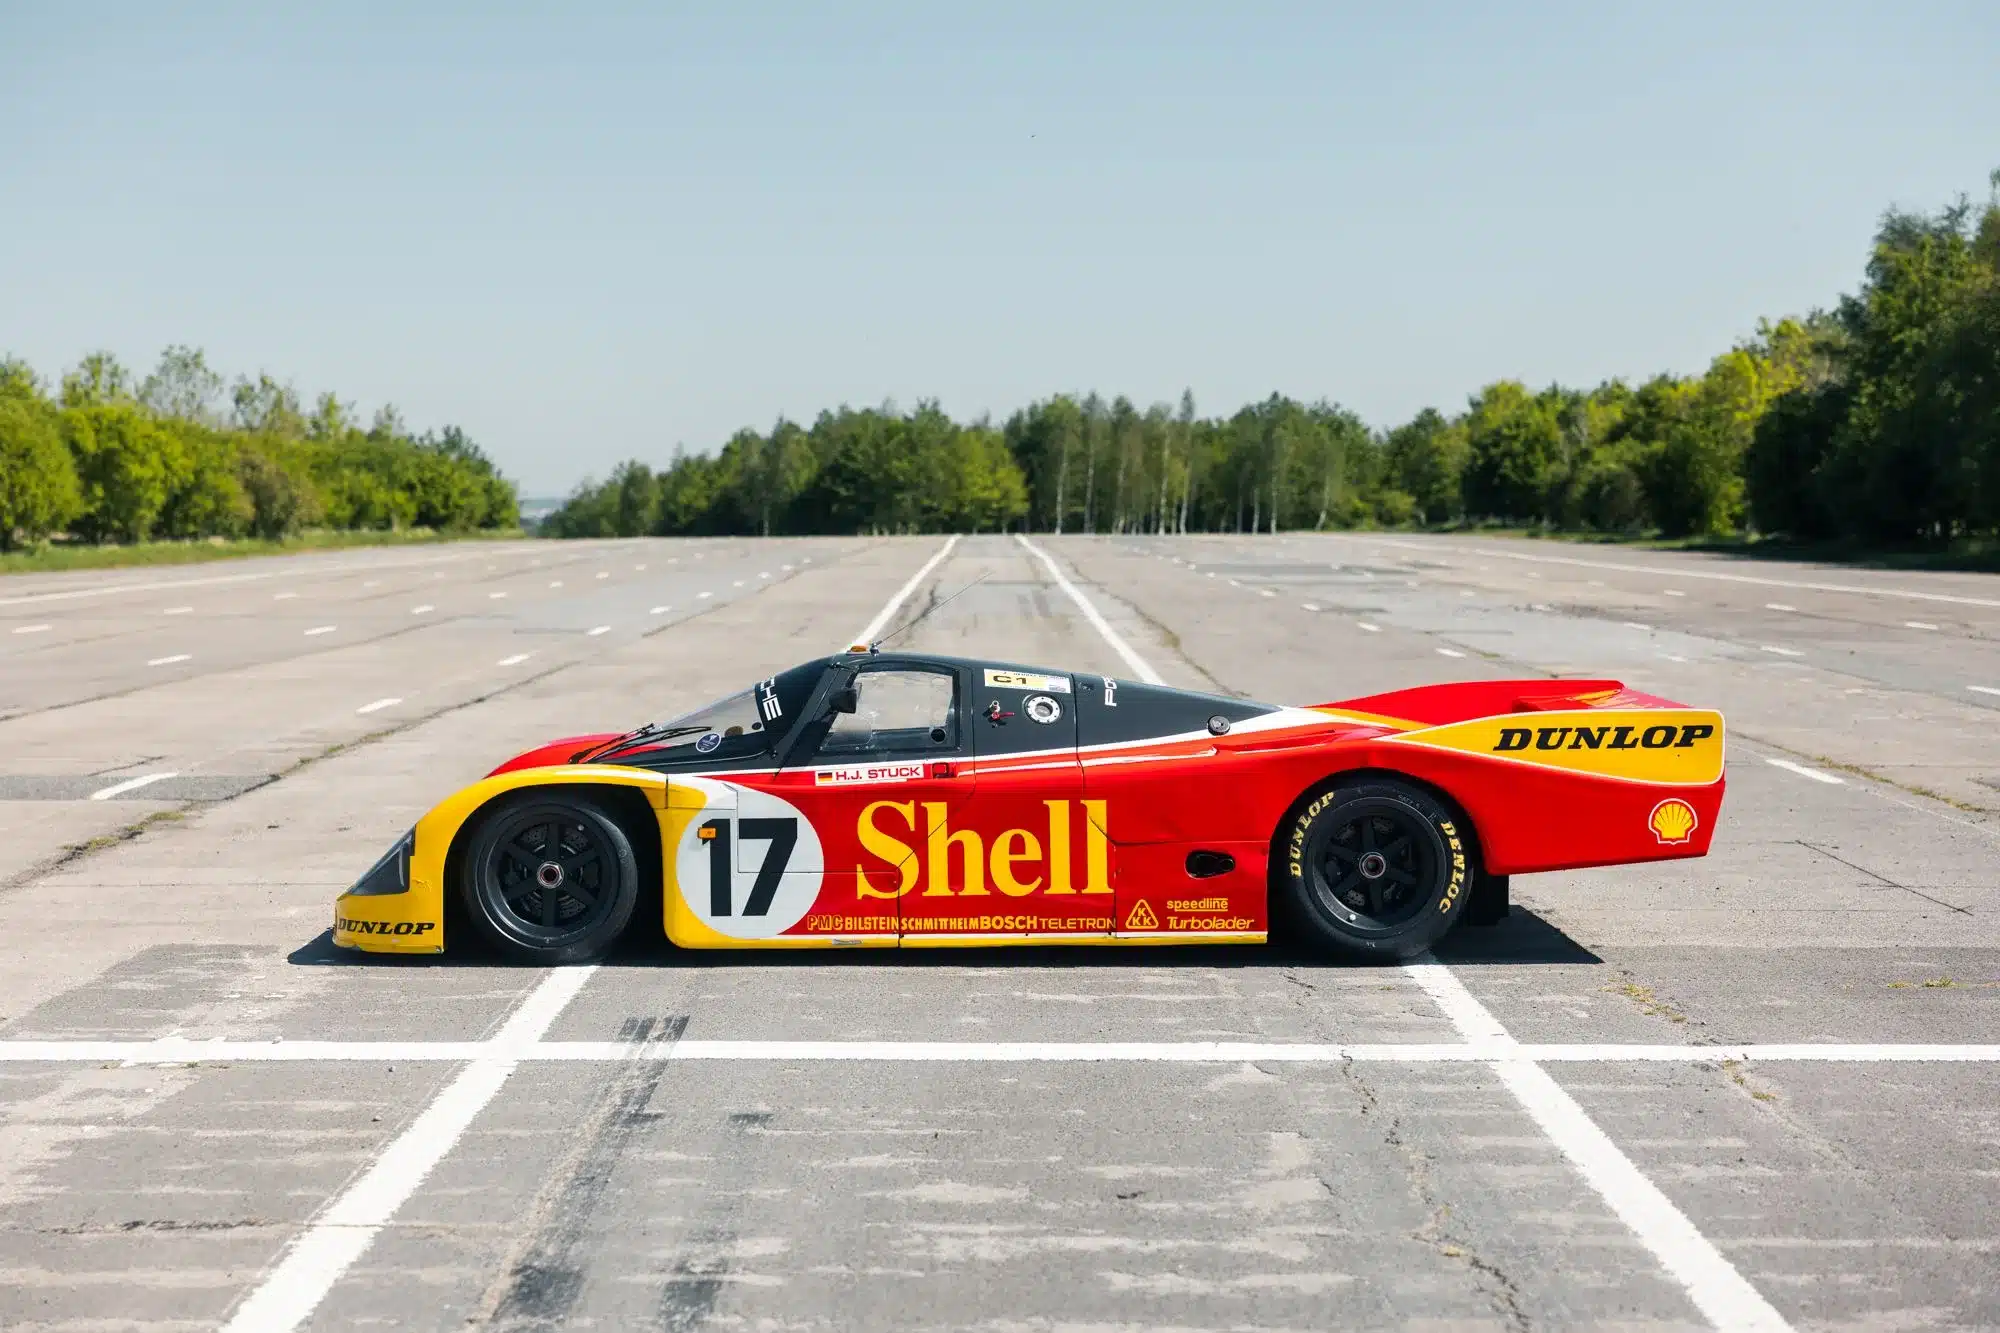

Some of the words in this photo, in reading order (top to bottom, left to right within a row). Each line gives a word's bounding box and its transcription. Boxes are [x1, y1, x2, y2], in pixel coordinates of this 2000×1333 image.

[993, 674, 1027, 685] C1
[1493, 724, 1713, 751] DUNLOP
[835, 770, 862, 781] H.J.
[868, 766, 921, 779] STUCK
[1289, 791, 1335, 878] DUNLOP
[856, 799, 1115, 900] Shell
[701, 817, 798, 917] 17
[1439, 820, 1466, 914] DENLOC
[1166, 898, 1229, 912] speedline
[338, 918, 435, 936] DUNLOP
[845, 917, 899, 931] BILSTEIN
[980, 915, 1037, 930] BOSCH
[1038, 917, 1116, 930] TELETRON
[1167, 916, 1254, 930] Turbolader
